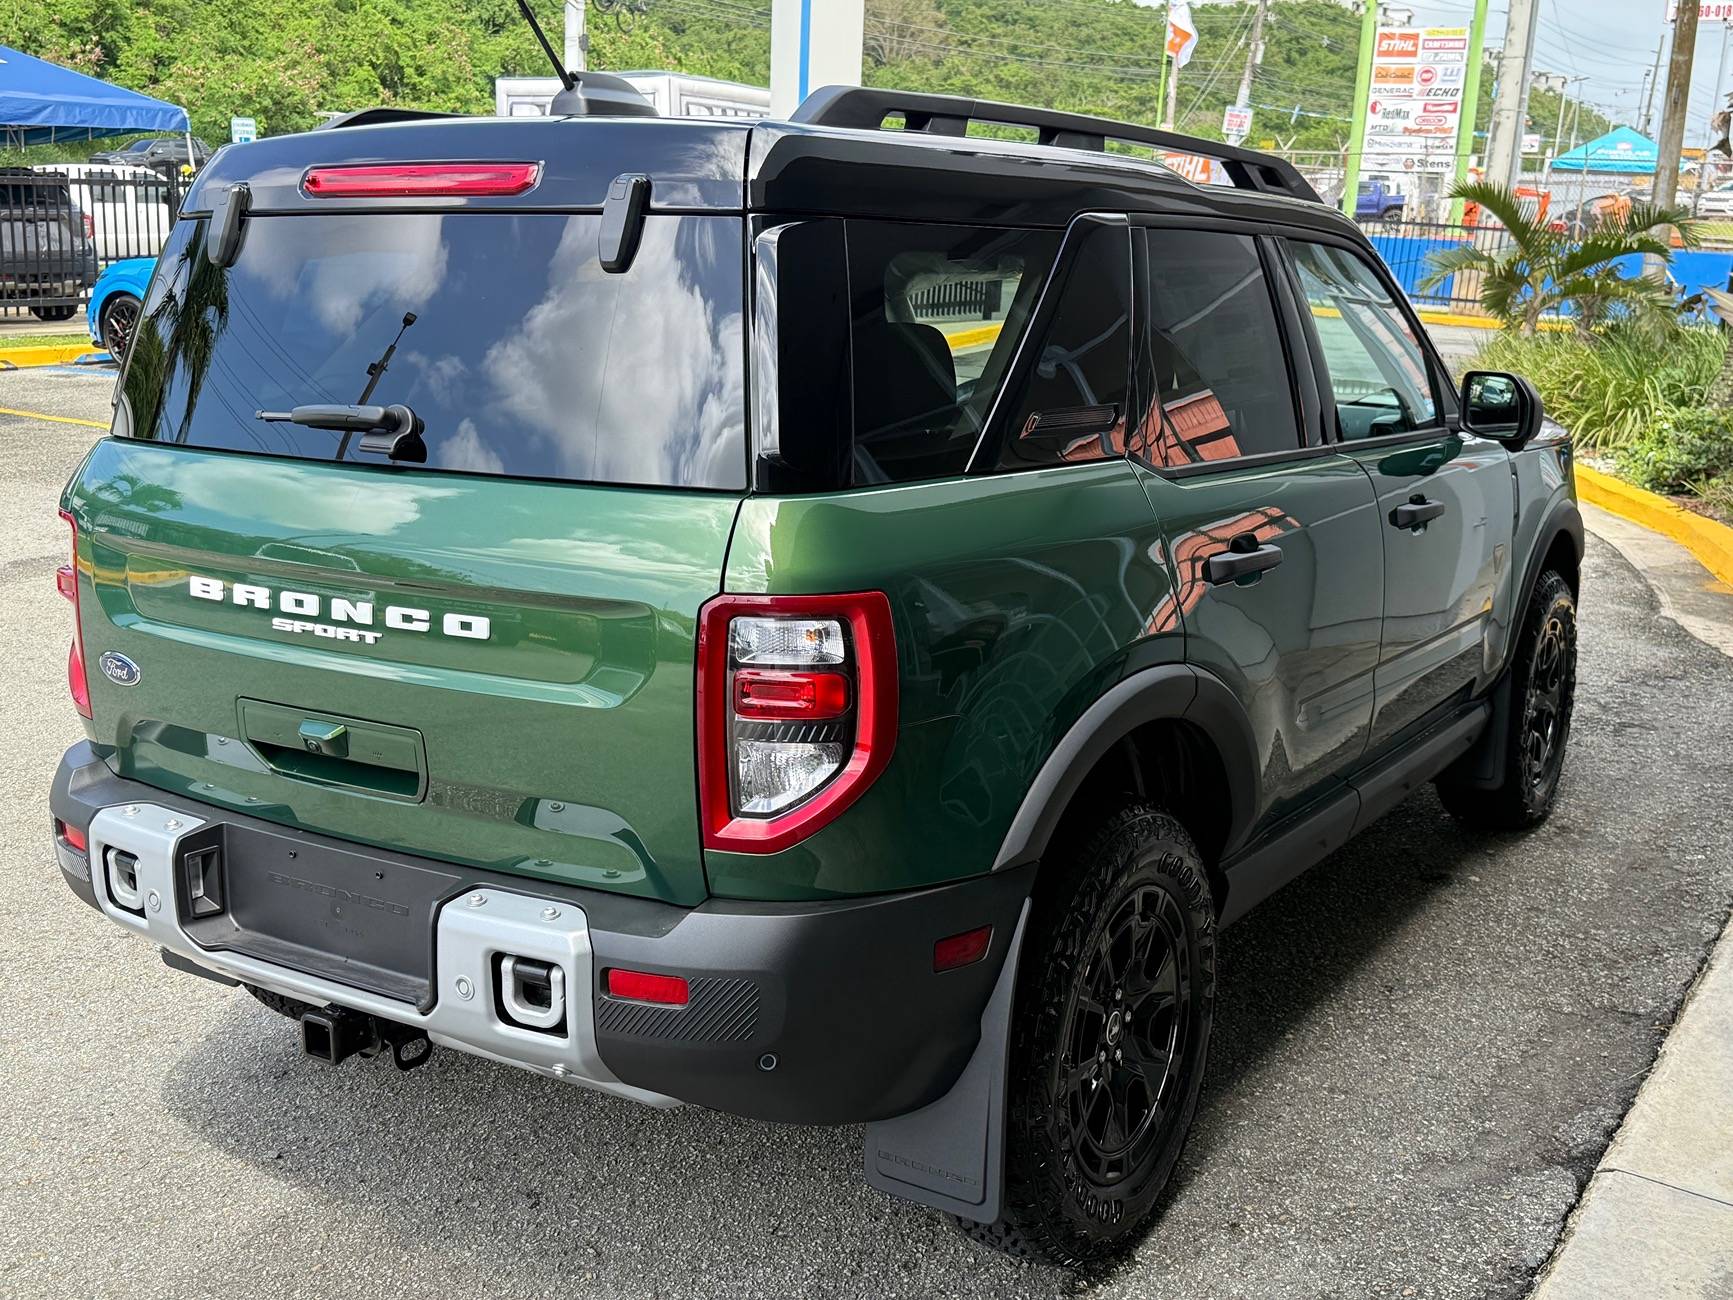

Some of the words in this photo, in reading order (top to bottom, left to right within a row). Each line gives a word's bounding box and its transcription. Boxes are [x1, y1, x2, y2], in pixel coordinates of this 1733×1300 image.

[1379, 40, 1416, 51] STIHL
[1426, 87, 1461, 97] ECHO
[1382, 107, 1411, 120] RedMax
[1416, 158, 1451, 168] Stens
[189, 575, 492, 641] BRONCO
[272, 617, 383, 645] SPORT
[106, 658, 129, 680] Ford
[268, 870, 409, 917] BRONCO
